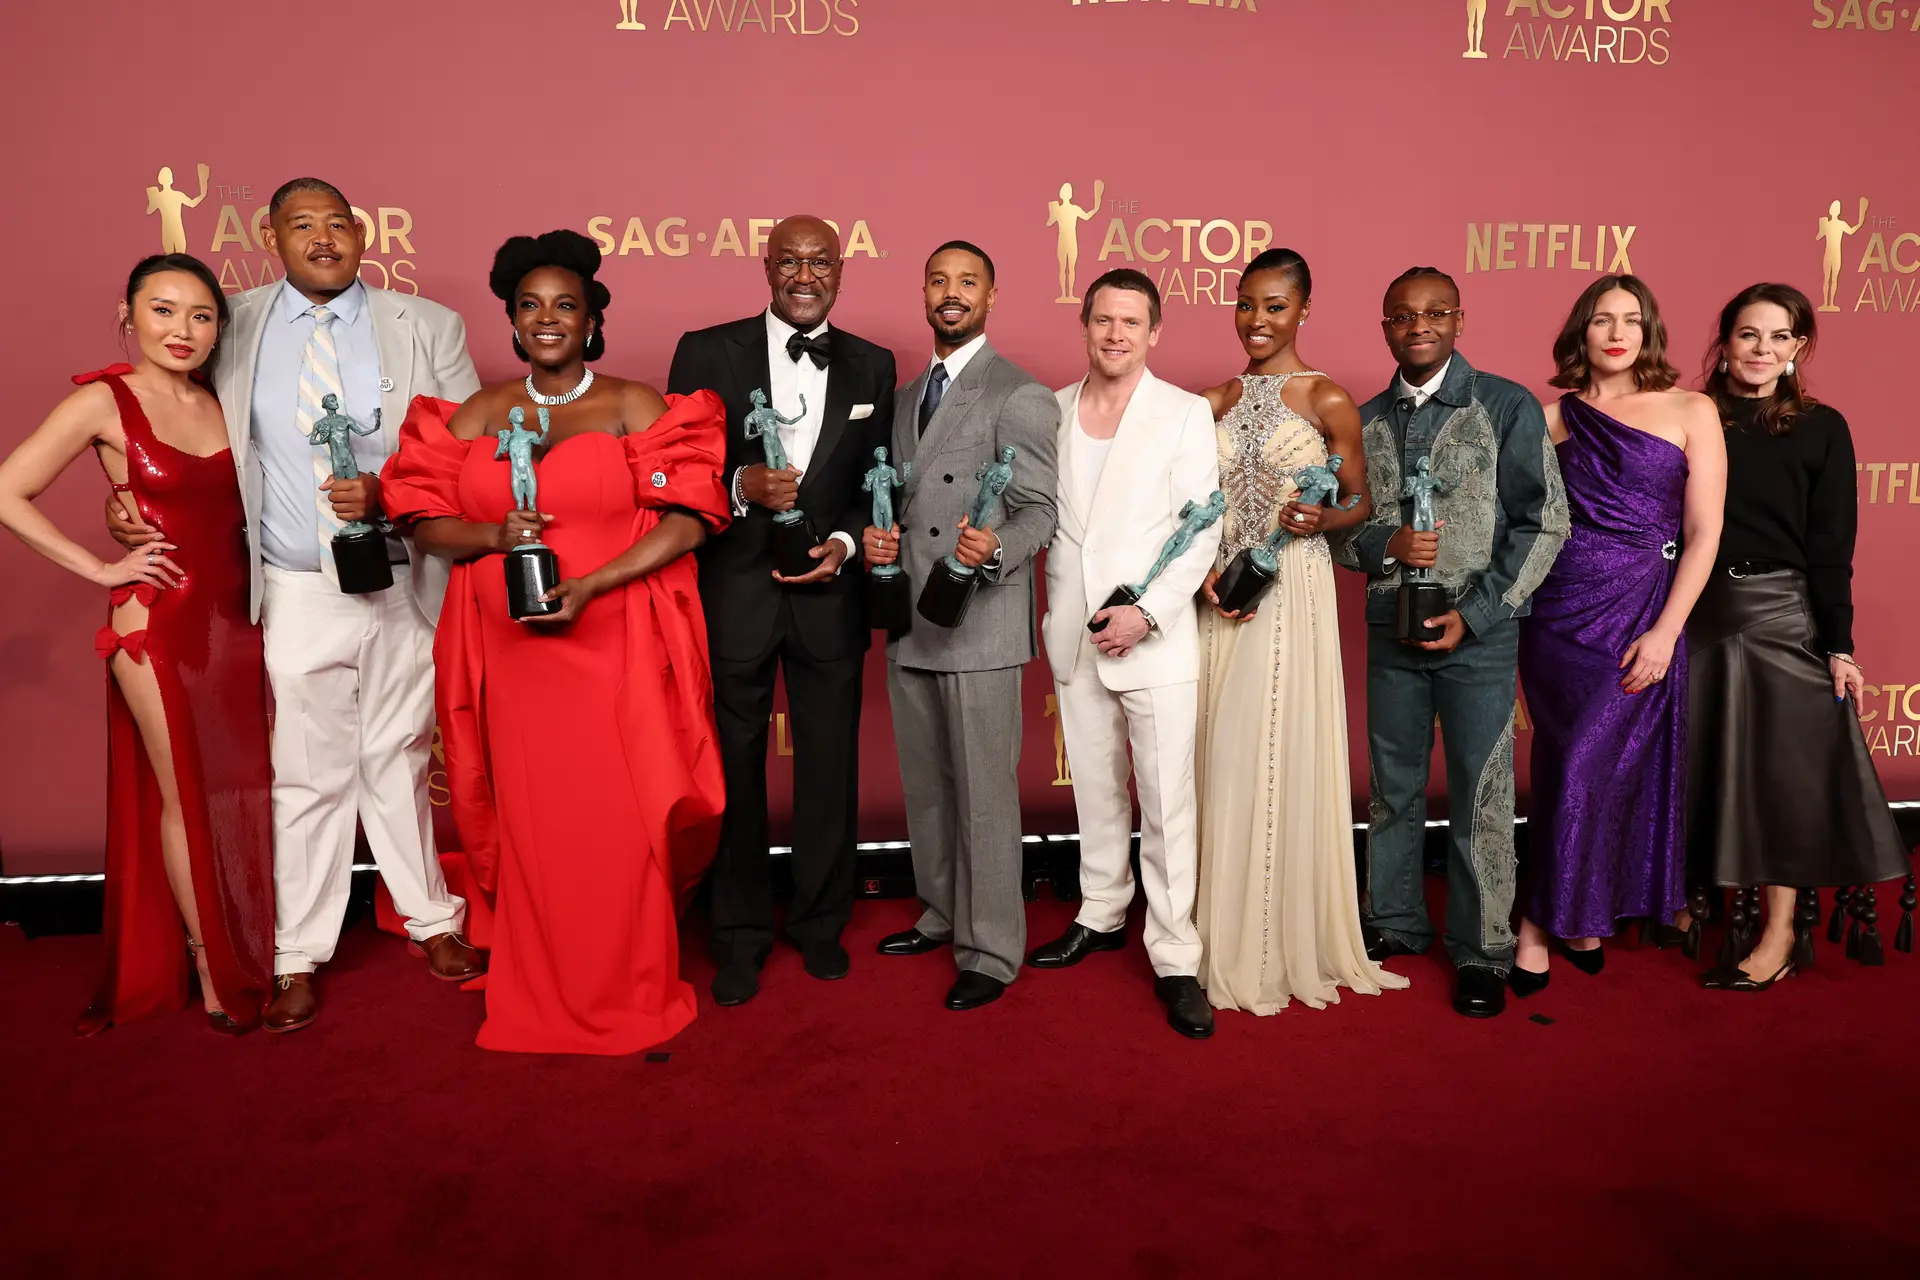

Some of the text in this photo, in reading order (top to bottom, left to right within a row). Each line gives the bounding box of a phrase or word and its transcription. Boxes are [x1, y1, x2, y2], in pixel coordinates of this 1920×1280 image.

[663, 0, 860, 36] AWARDS
[1503, 22, 1671, 66] AWARDS
[216, 185, 253, 200] THE
[1109, 199, 1140, 215] THE
[1097, 217, 1275, 265] ACTOR
[1871, 215, 1898, 229] THE
[1465, 222, 1637, 275] NETFLIX
[1856, 462, 1920, 504] TFL
